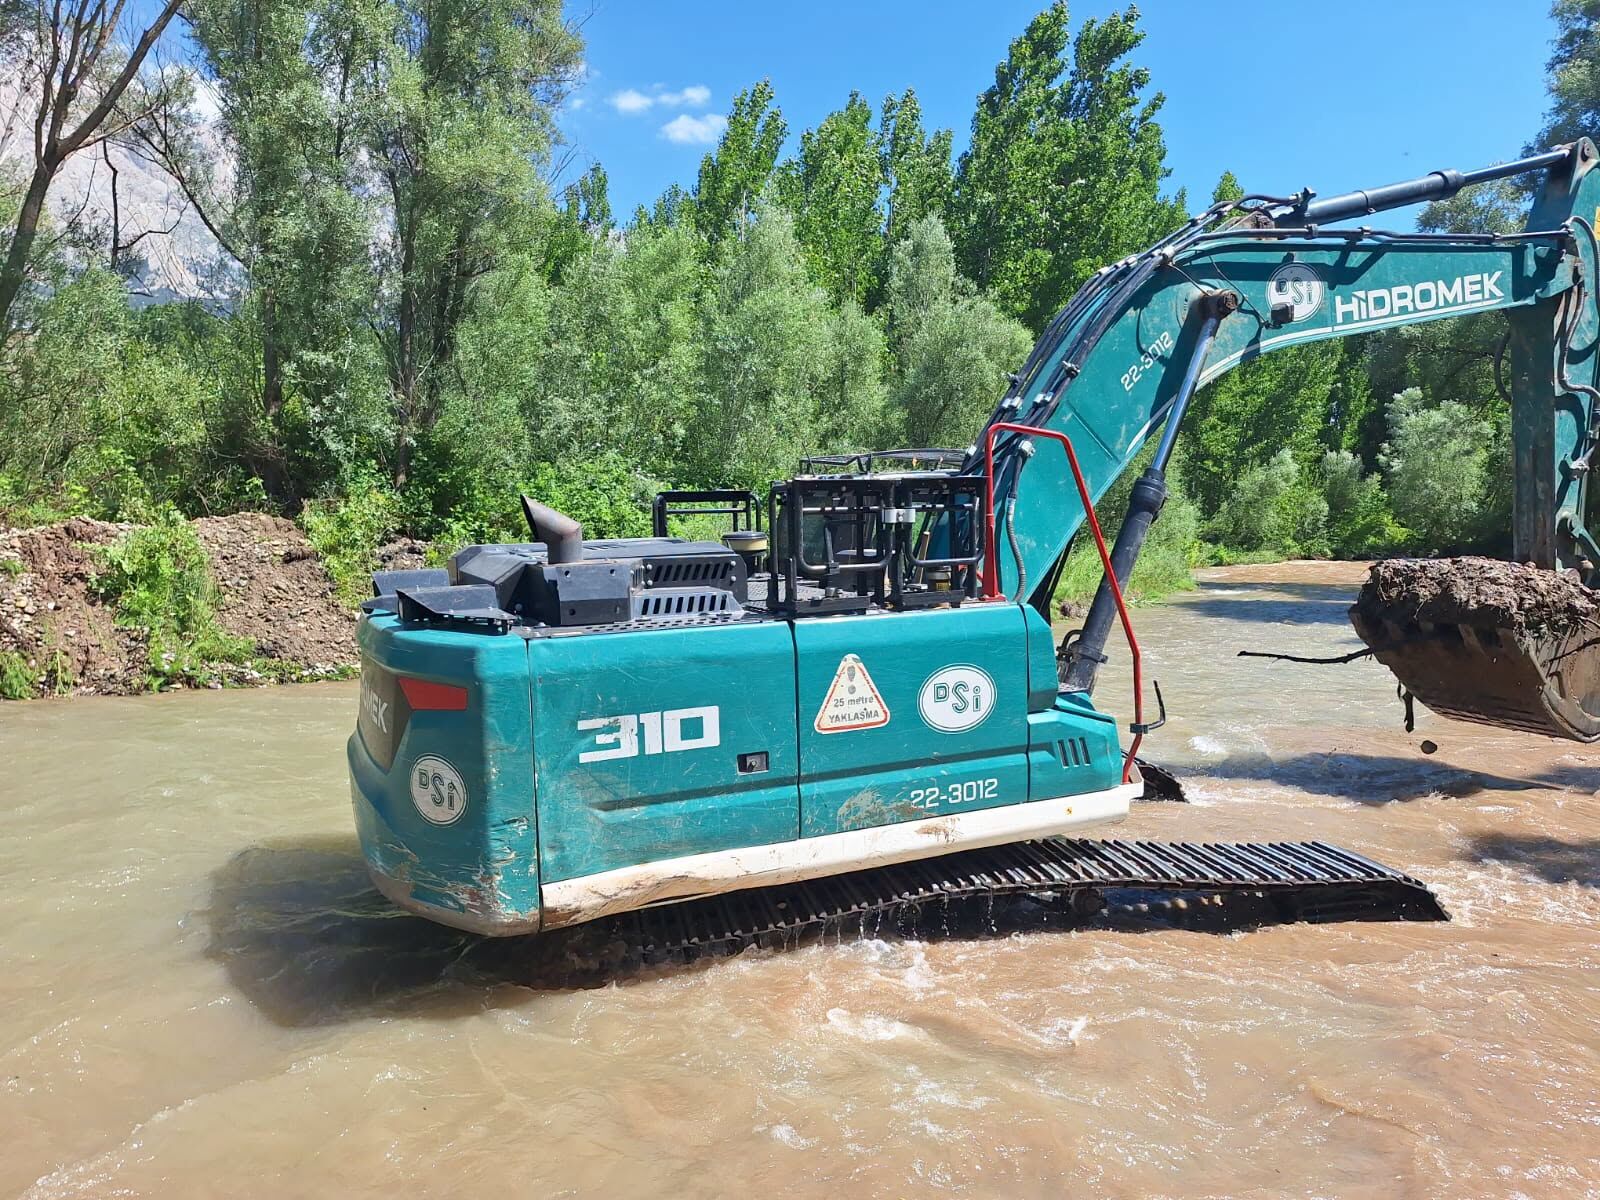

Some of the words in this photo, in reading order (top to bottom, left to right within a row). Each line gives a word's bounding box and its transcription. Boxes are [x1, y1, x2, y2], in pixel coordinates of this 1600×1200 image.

[1121, 331, 1174, 391] 22-3012
[829, 709, 880, 724] YAKLAŞMA
[833, 698, 845, 708] 25
[848, 696, 874, 706] metre
[577, 705, 721, 764] 310
[910, 778, 998, 809] 22-3012
